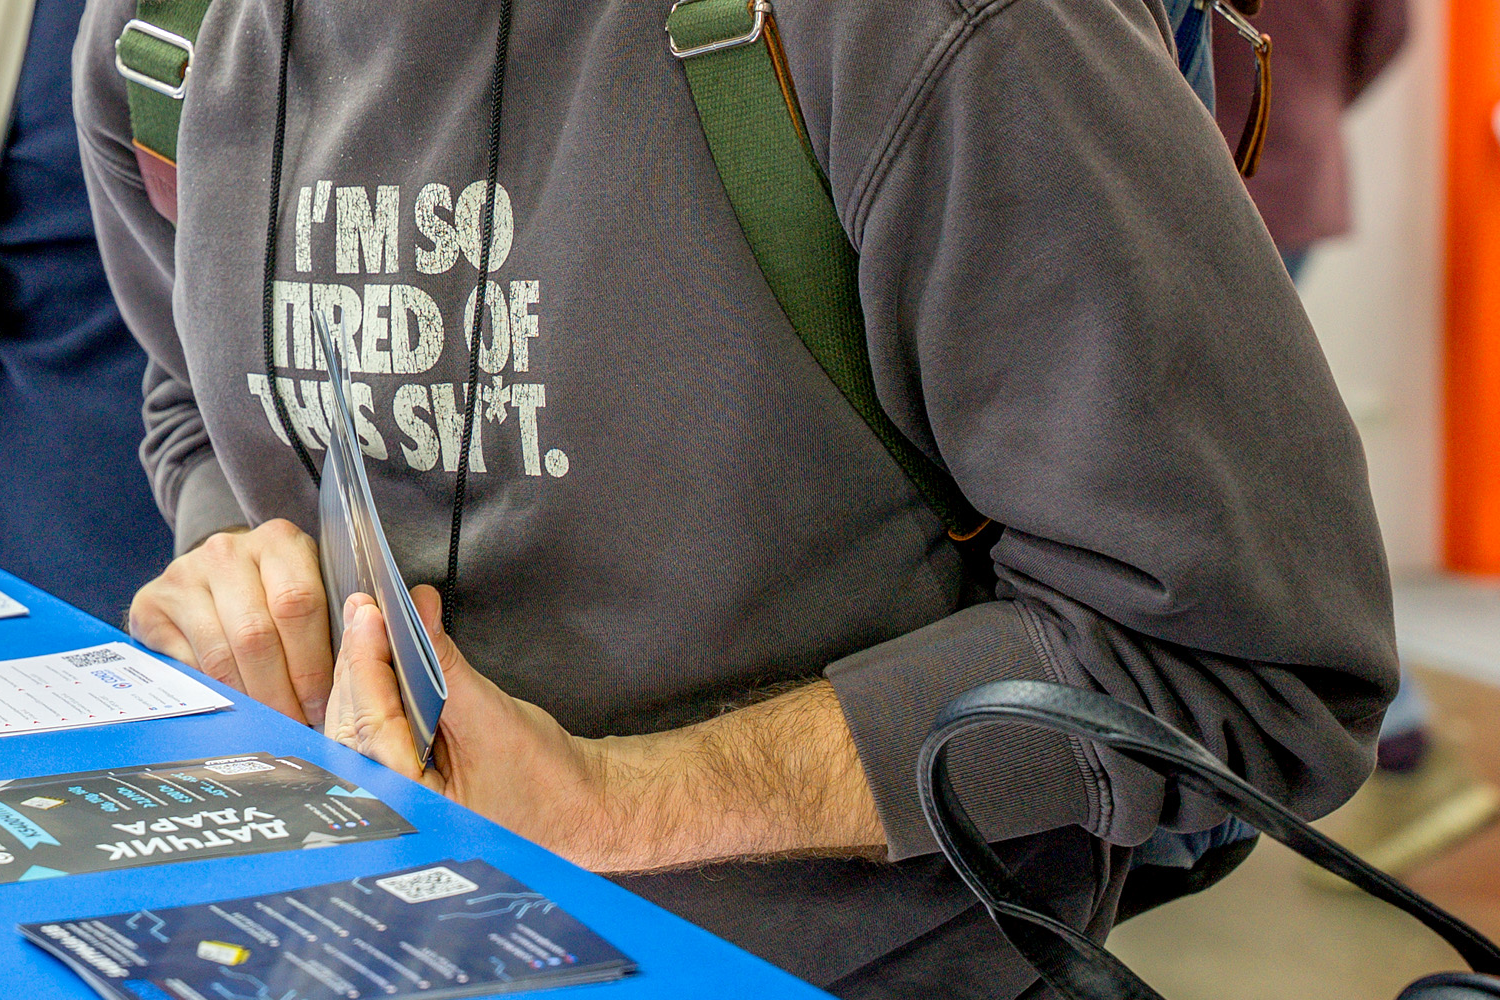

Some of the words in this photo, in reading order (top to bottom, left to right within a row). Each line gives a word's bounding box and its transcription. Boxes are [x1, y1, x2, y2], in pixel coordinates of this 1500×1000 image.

[295, 180, 400, 274] I'M
[414, 179, 514, 275] SO
[272, 280, 445, 374] TIRED
[463, 280, 540, 374] OF
[95, 818, 290, 861] ДАТЧИК
[111, 806, 276, 836] УДАРА
